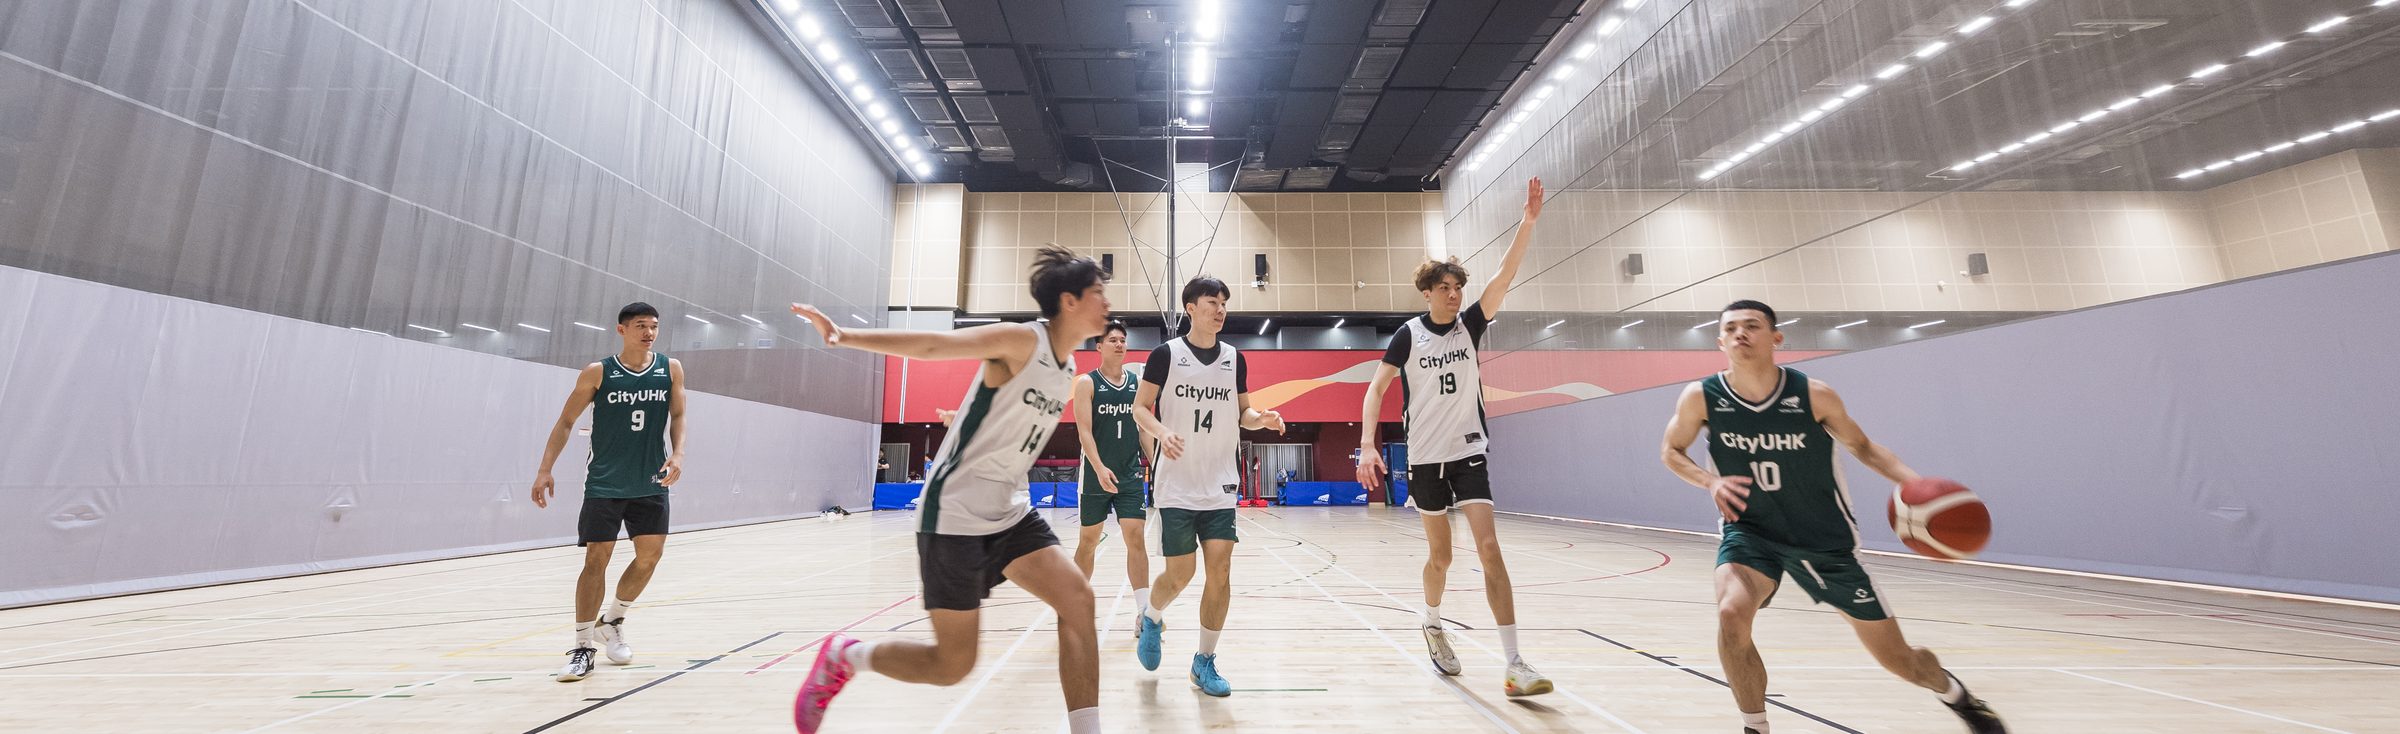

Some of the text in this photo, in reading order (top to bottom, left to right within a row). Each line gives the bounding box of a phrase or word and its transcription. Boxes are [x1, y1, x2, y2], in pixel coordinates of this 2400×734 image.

[1419, 348, 1470, 369] CityUHK
[1175, 384, 1231, 402] CityUHK
[1439, 372, 1457, 395] 19
[607, 389, 668, 405] CityUHK
[631, 409, 645, 432] 9
[1098, 403, 1133, 417] CityUH
[1117, 420, 1122, 439] 1
[1194, 409, 1213, 434] 14
[1720, 432, 1807, 454] CityUHK
[1749, 461, 1782, 492] 10
